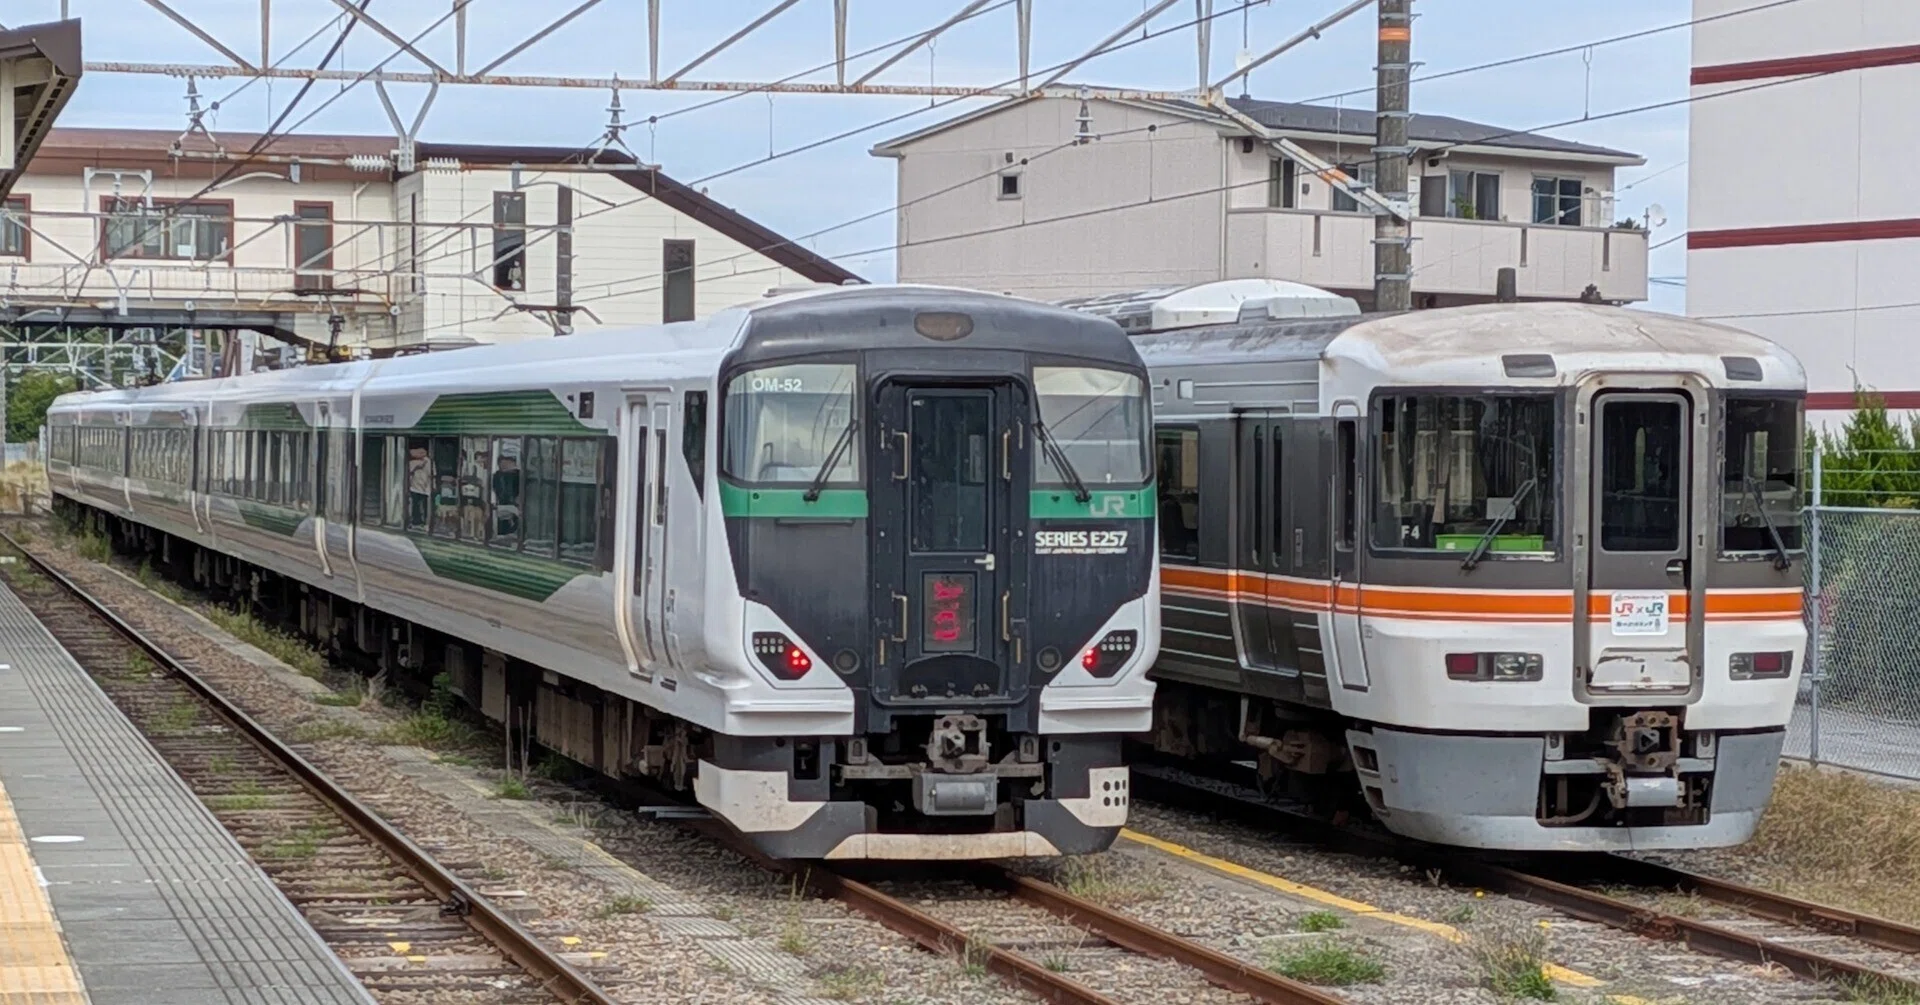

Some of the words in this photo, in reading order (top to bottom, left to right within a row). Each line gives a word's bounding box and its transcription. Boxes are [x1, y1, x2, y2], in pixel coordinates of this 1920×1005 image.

[752, 378, 802, 391] OM-52
[1090, 496, 1124, 518] JR
[1035, 531, 1088, 547] SERIES
[1090, 531, 1128, 547] E257
[1401, 525, 1420, 539] F4
[1615, 602, 1634, 614] JR
[1645, 602, 1664, 614] JR
